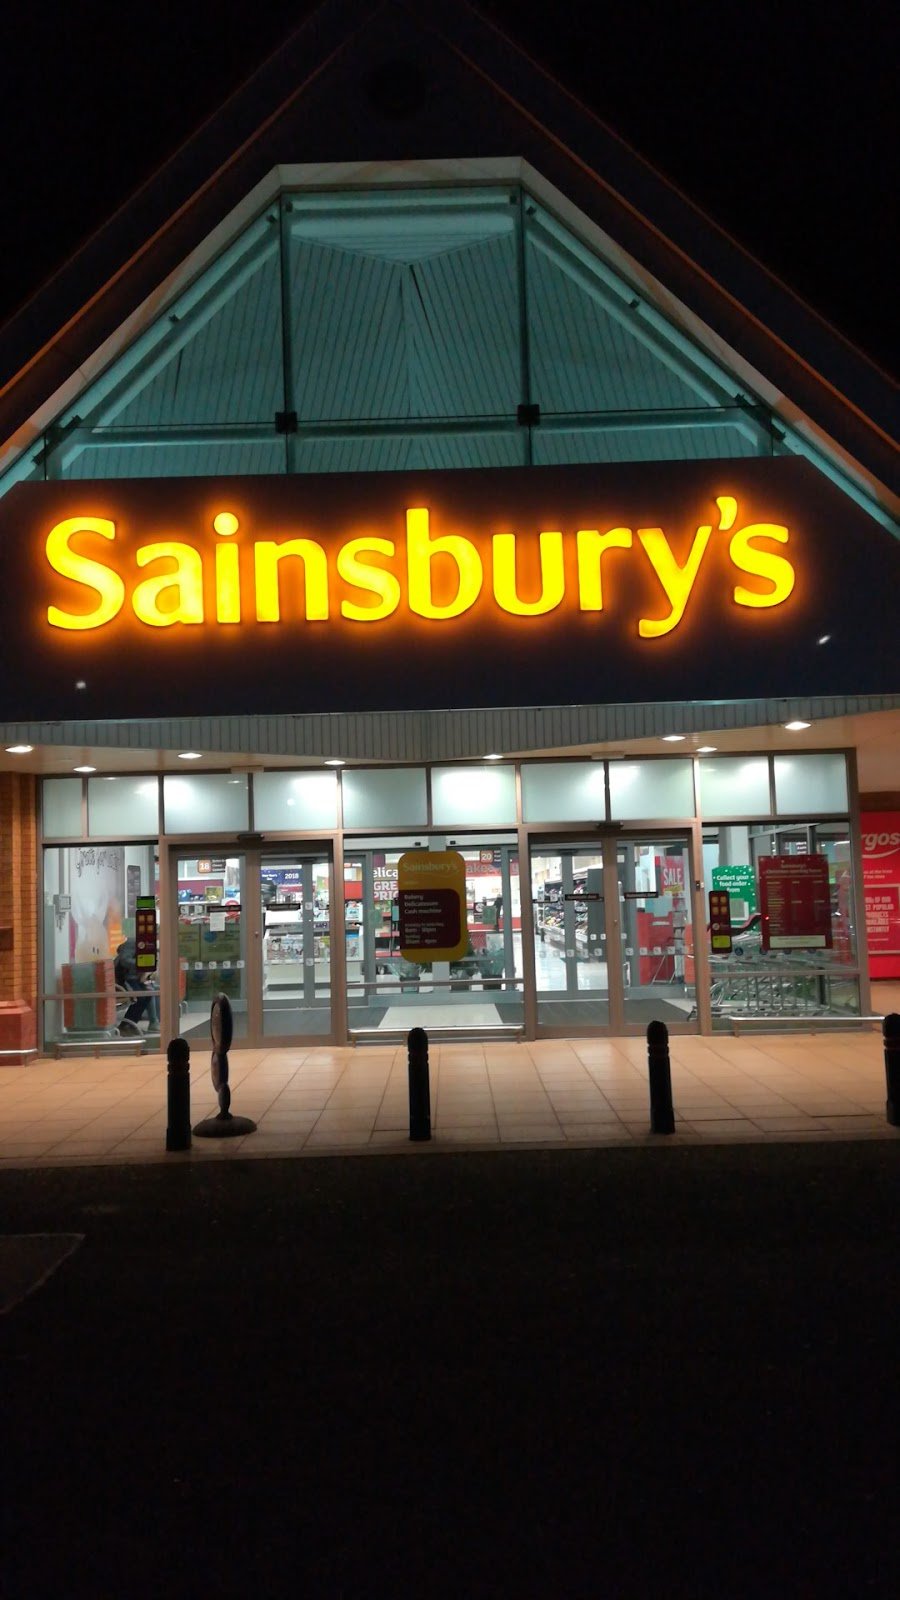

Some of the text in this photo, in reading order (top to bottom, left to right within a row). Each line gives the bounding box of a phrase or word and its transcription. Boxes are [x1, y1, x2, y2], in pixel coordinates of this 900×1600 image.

[46, 496, 796, 638] Sainsbury's
[200, 862, 209, 870] 18
[402, 860, 460, 874] Sainsbury's
[284, 872, 299, 880] 2018
[663, 867, 683, 885] SALE
[736, 874, 749, 882] your
